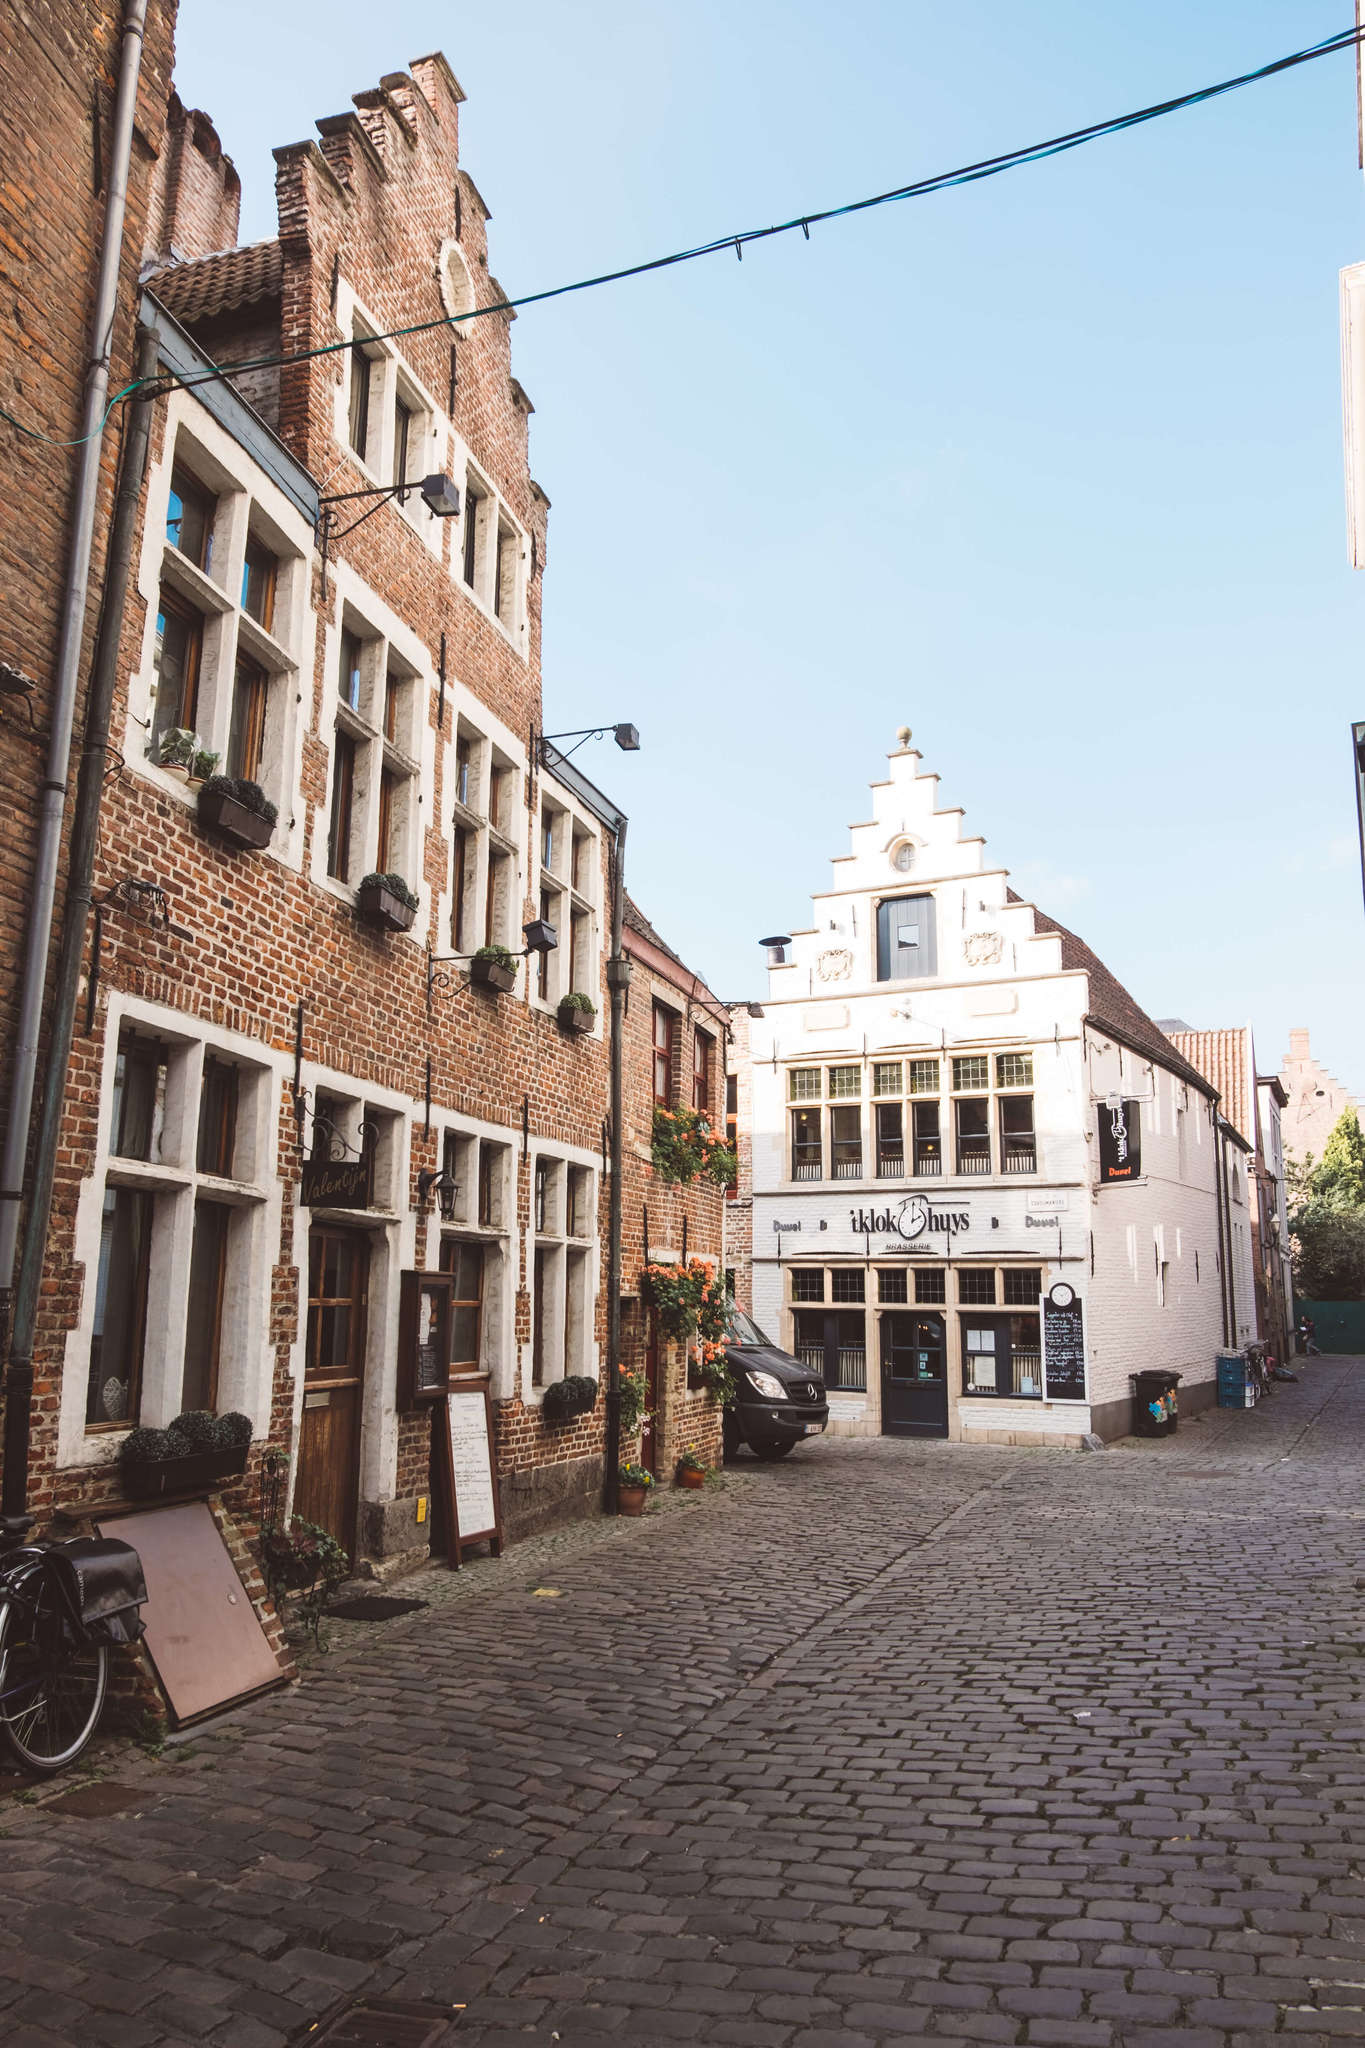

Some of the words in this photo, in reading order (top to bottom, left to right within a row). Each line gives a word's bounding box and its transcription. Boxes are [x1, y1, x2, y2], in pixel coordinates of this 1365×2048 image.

[1109, 1166, 1131, 1177] Duvel
[304, 1165, 367, 1204] Valentijn
[773, 1220, 802, 1232] Duvel
[1025, 1215, 1059, 1228] Duvel
